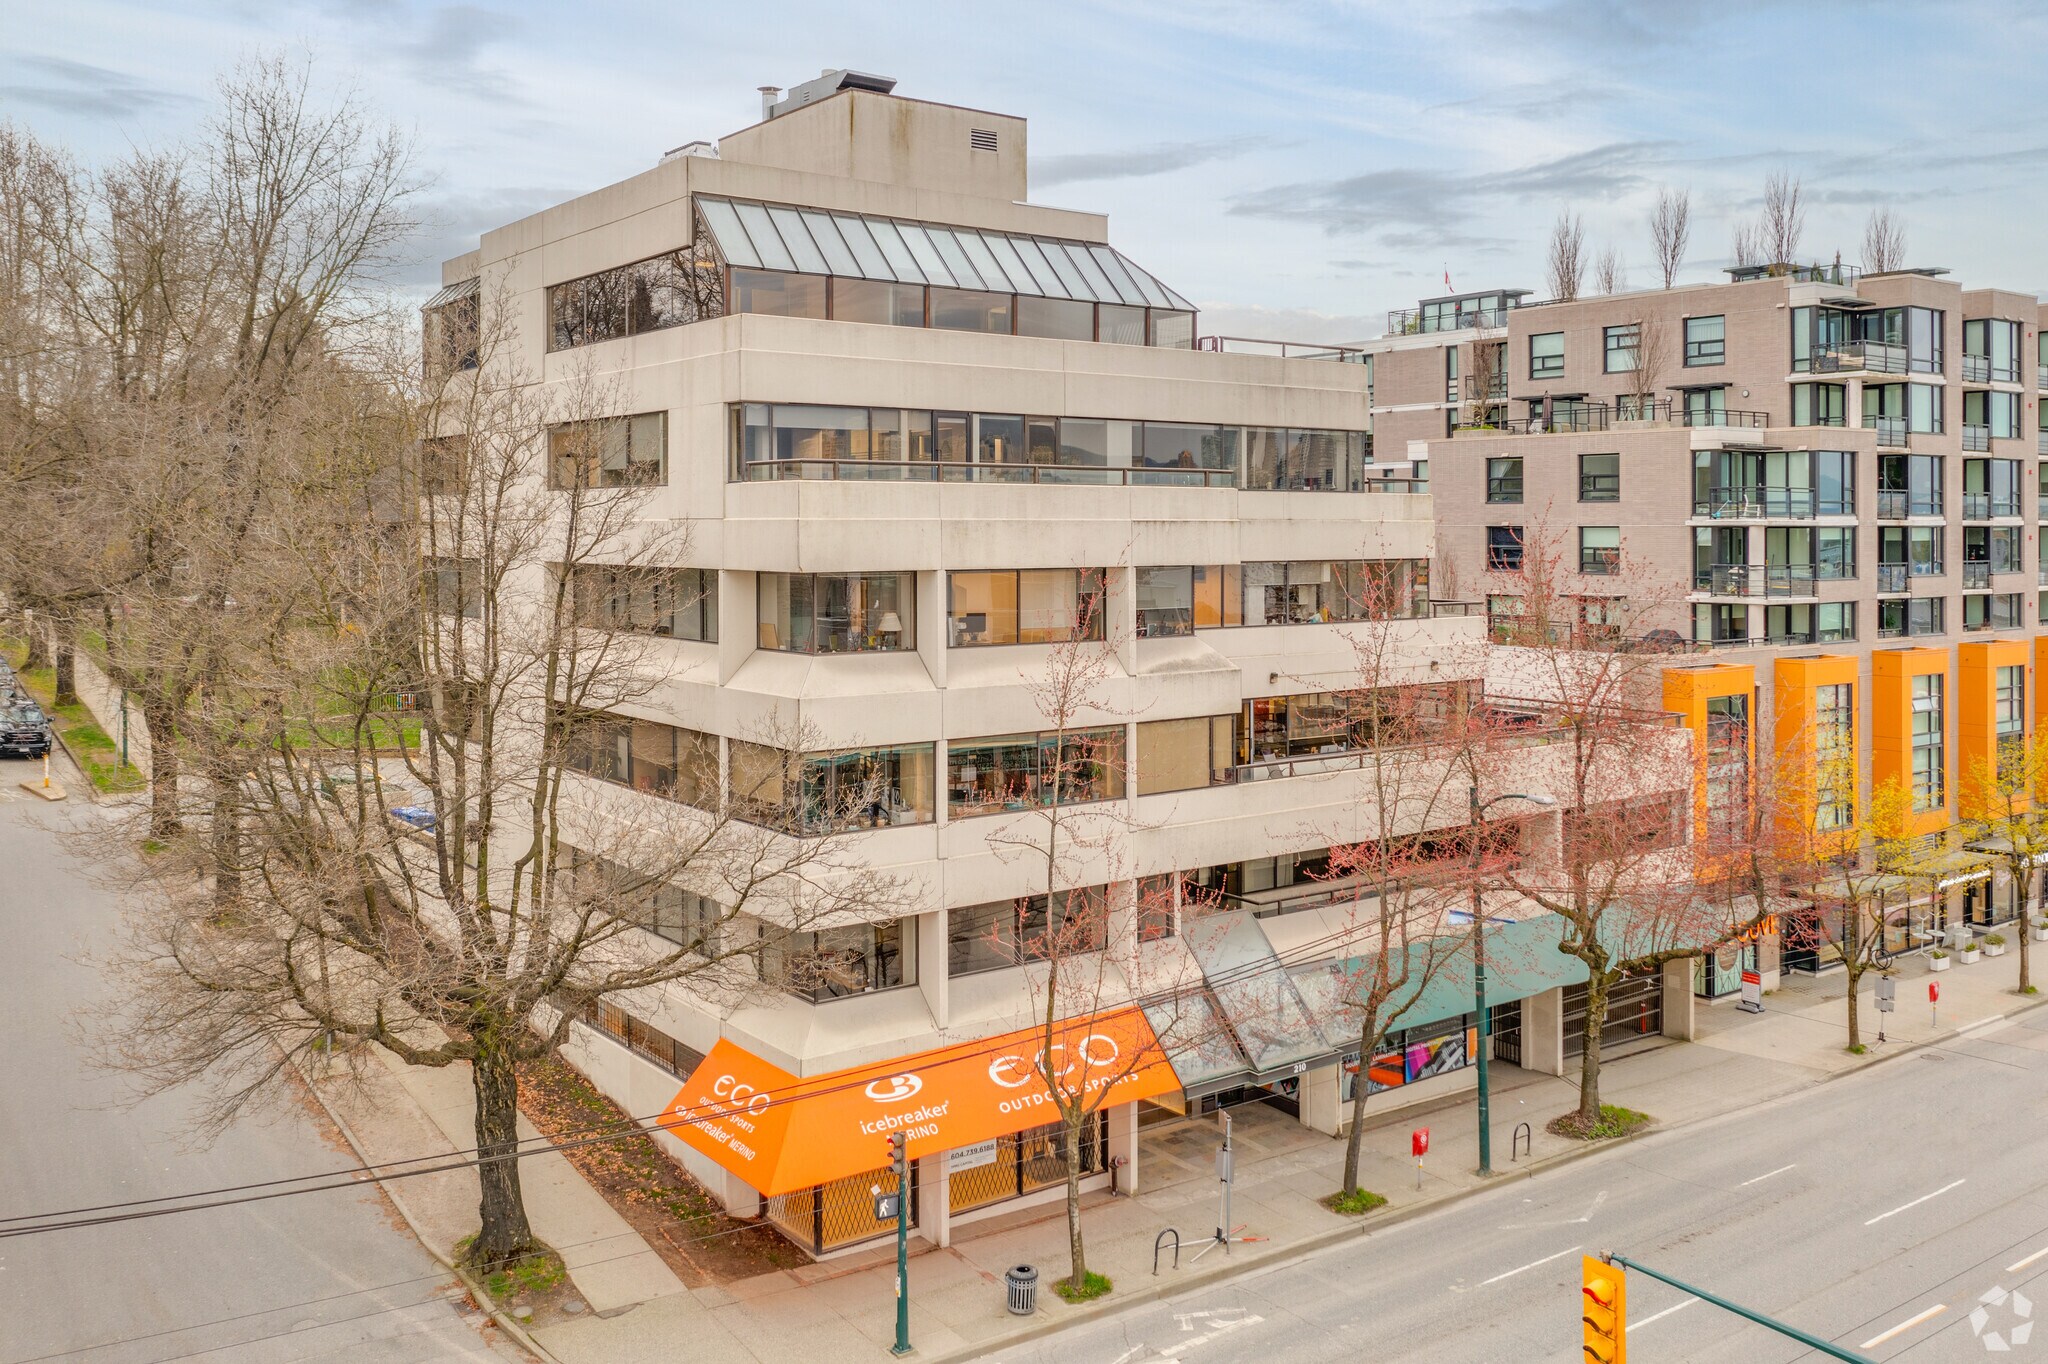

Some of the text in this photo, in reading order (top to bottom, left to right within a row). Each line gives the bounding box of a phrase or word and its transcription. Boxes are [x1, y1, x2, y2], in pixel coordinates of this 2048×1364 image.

[1293, 1062, 1307, 1073] 210
[999, 1085, 1080, 1113] OUTDOOR
[729, 1114, 756, 1134] SPORTS
[727, 1138, 756, 1161] MERINO
[950, 1143, 995, 1160] 604.739.6188
